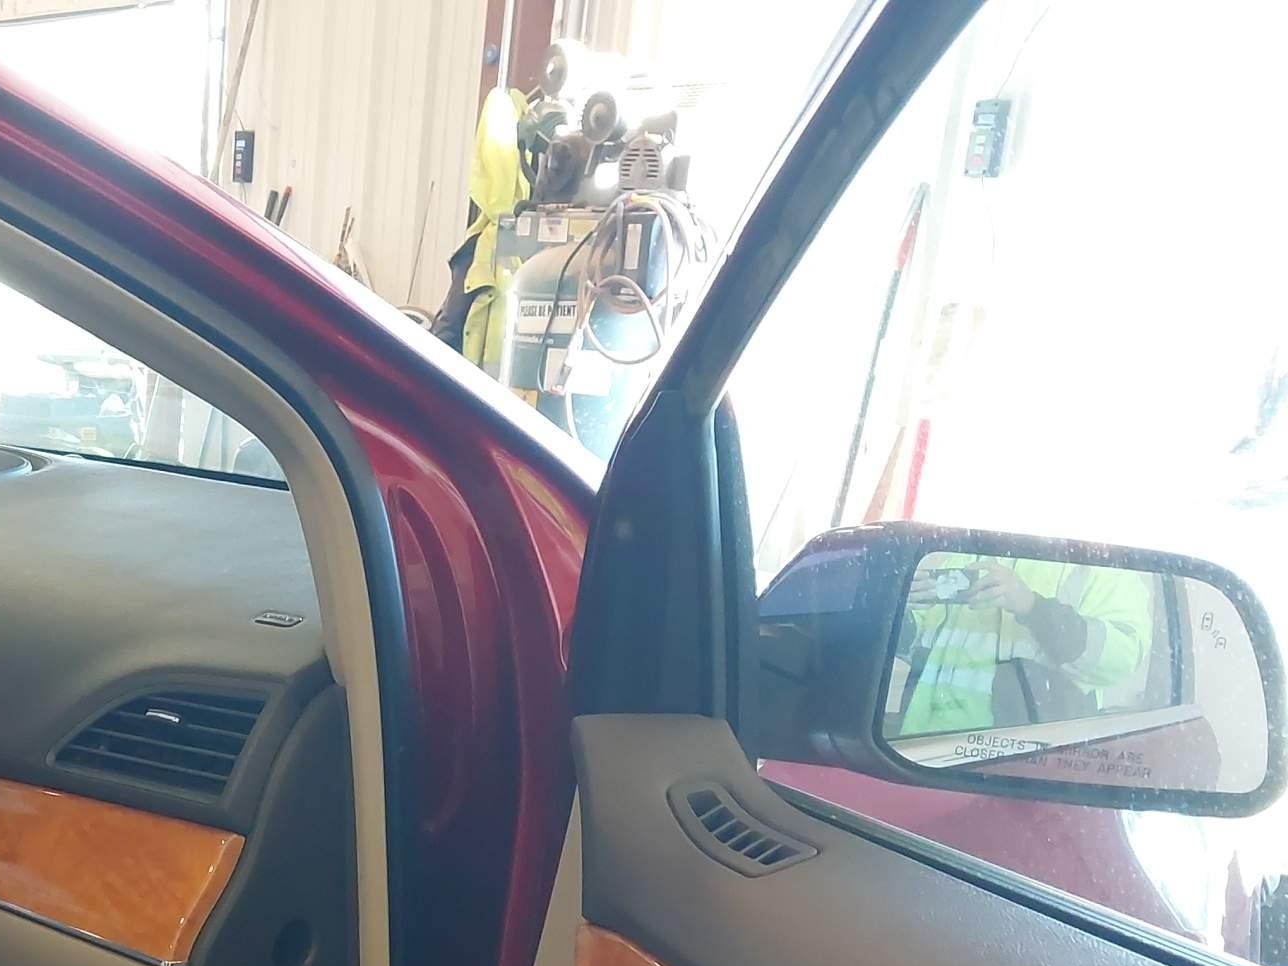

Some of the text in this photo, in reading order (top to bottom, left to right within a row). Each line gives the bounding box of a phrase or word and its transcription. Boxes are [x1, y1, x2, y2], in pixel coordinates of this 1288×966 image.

[538, 304, 546, 317] BE
[547, 304, 577, 317] PTIENT
[967, 734, 1026, 751] OBJECTS
[1096, 762, 1152, 779] APPEAR
